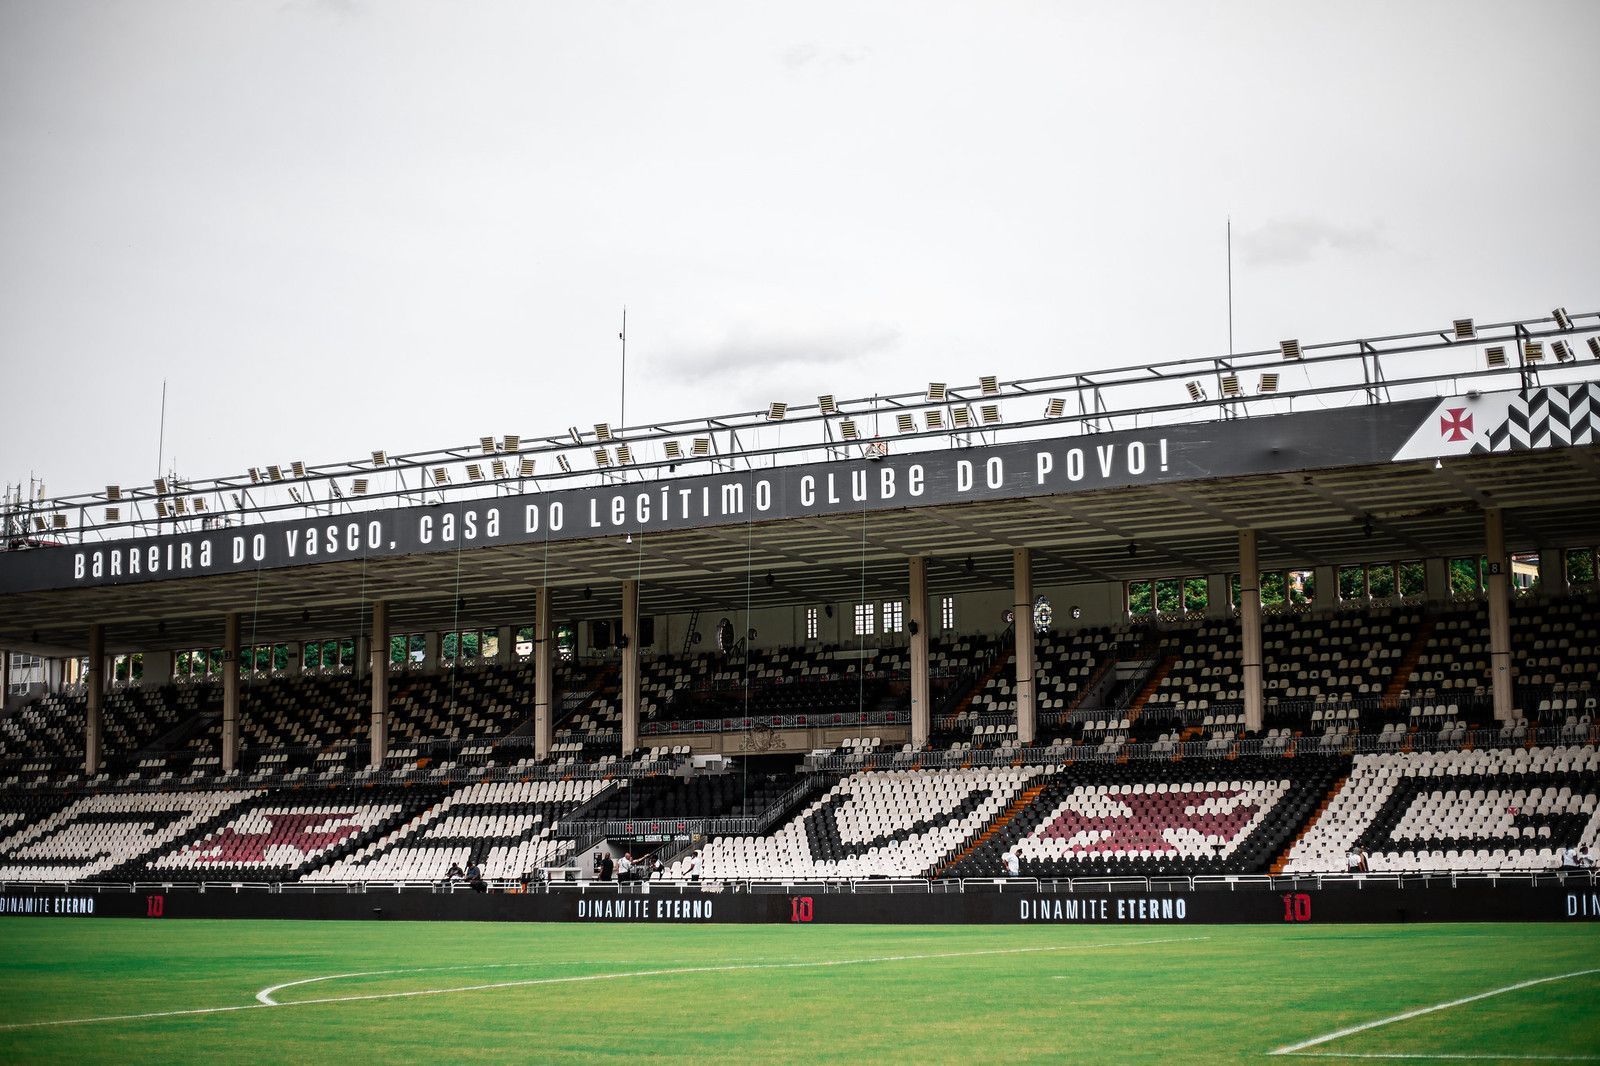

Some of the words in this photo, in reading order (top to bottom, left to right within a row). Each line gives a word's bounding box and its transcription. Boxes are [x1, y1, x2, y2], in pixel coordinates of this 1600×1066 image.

[232, 533, 266, 564] DO
[525, 501, 564, 534] DO
[956, 456, 1004, 494] DO
[1036, 438, 1169, 485] POVO!
[1492, 564, 1498, 573] 8
[0, 897, 49, 913] DINAMITE
[54, 897, 94, 914] ETERNO
[147, 895, 164, 917] 10
[578, 899, 650, 918] DINAMITE
[656, 899, 713, 919] ETERNO
[791, 896, 814, 922] 10
[1020, 899, 1108, 920] DINAMITE
[1117, 898, 1187, 920] ETERNO
[1284, 894, 1311, 922] 10
[1567, 894, 1600, 916] DIN
